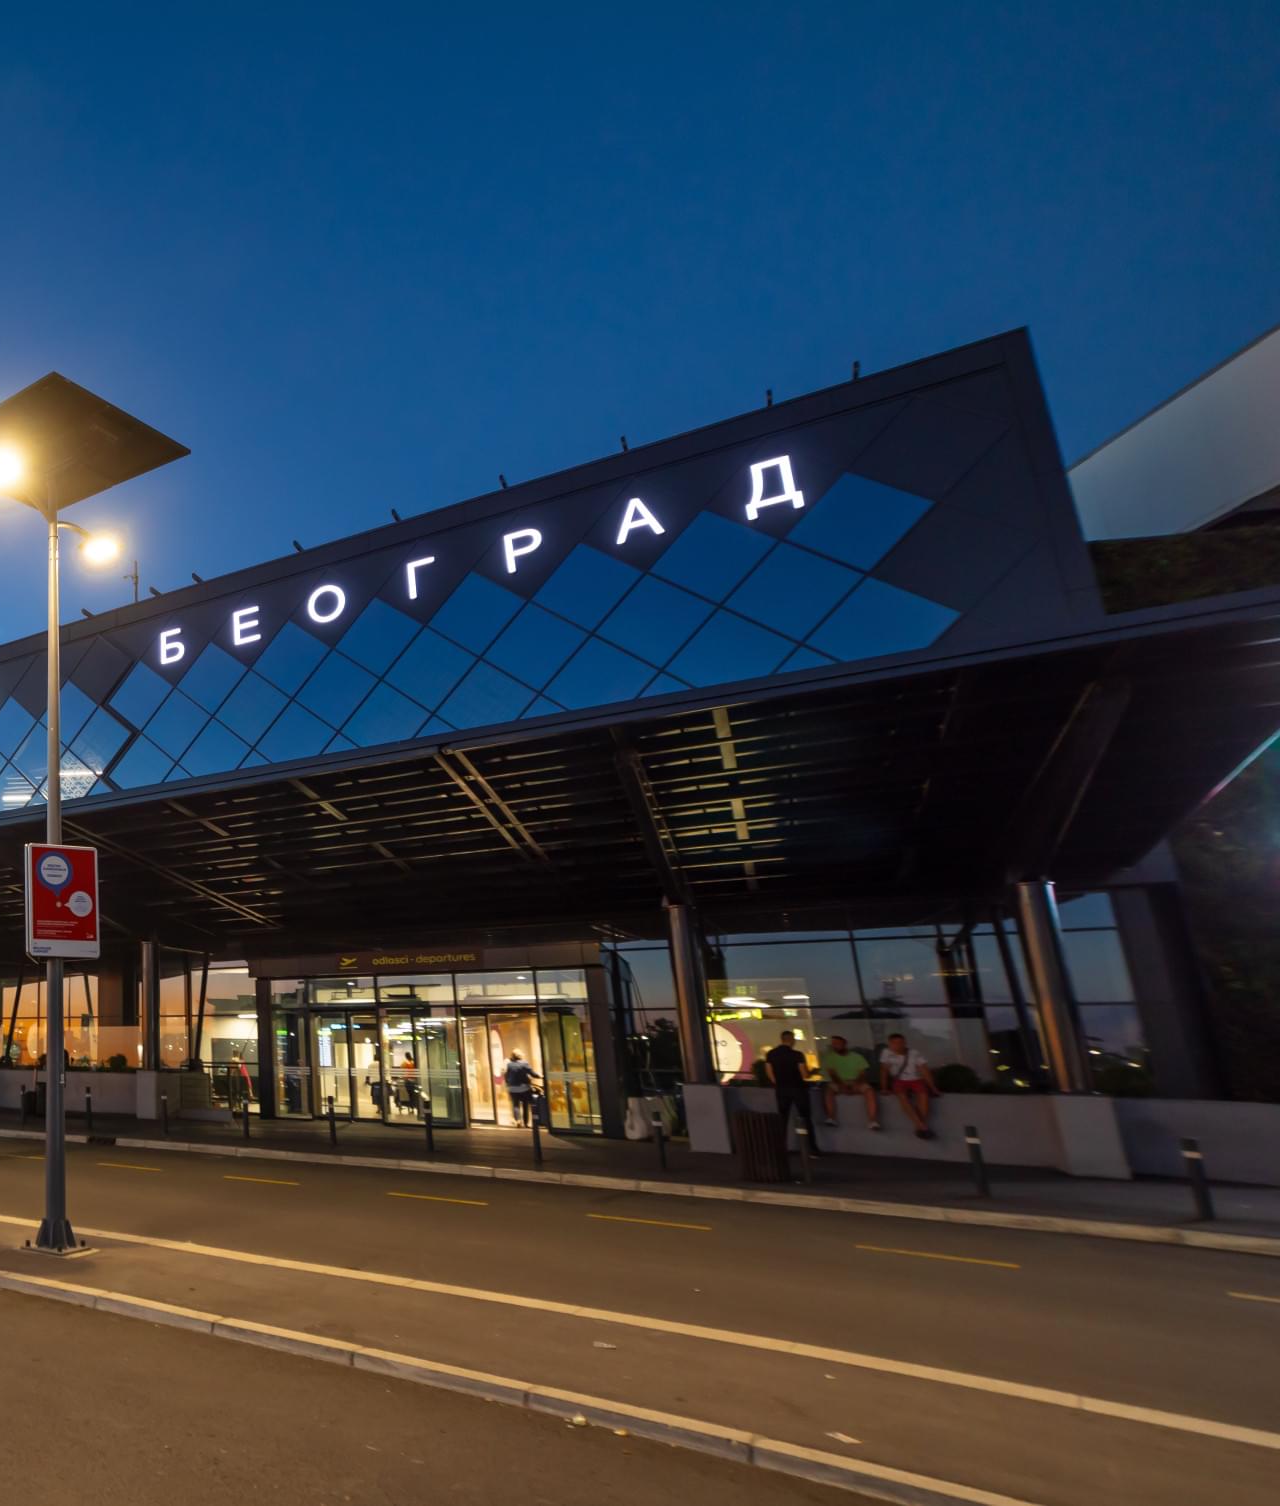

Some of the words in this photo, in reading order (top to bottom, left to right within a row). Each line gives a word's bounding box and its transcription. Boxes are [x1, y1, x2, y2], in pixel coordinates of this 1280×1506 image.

[159, 454, 805, 665] БЕОГРАД
[372, 955, 409, 965] odlasci
[415, 953, 475, 964] departures
